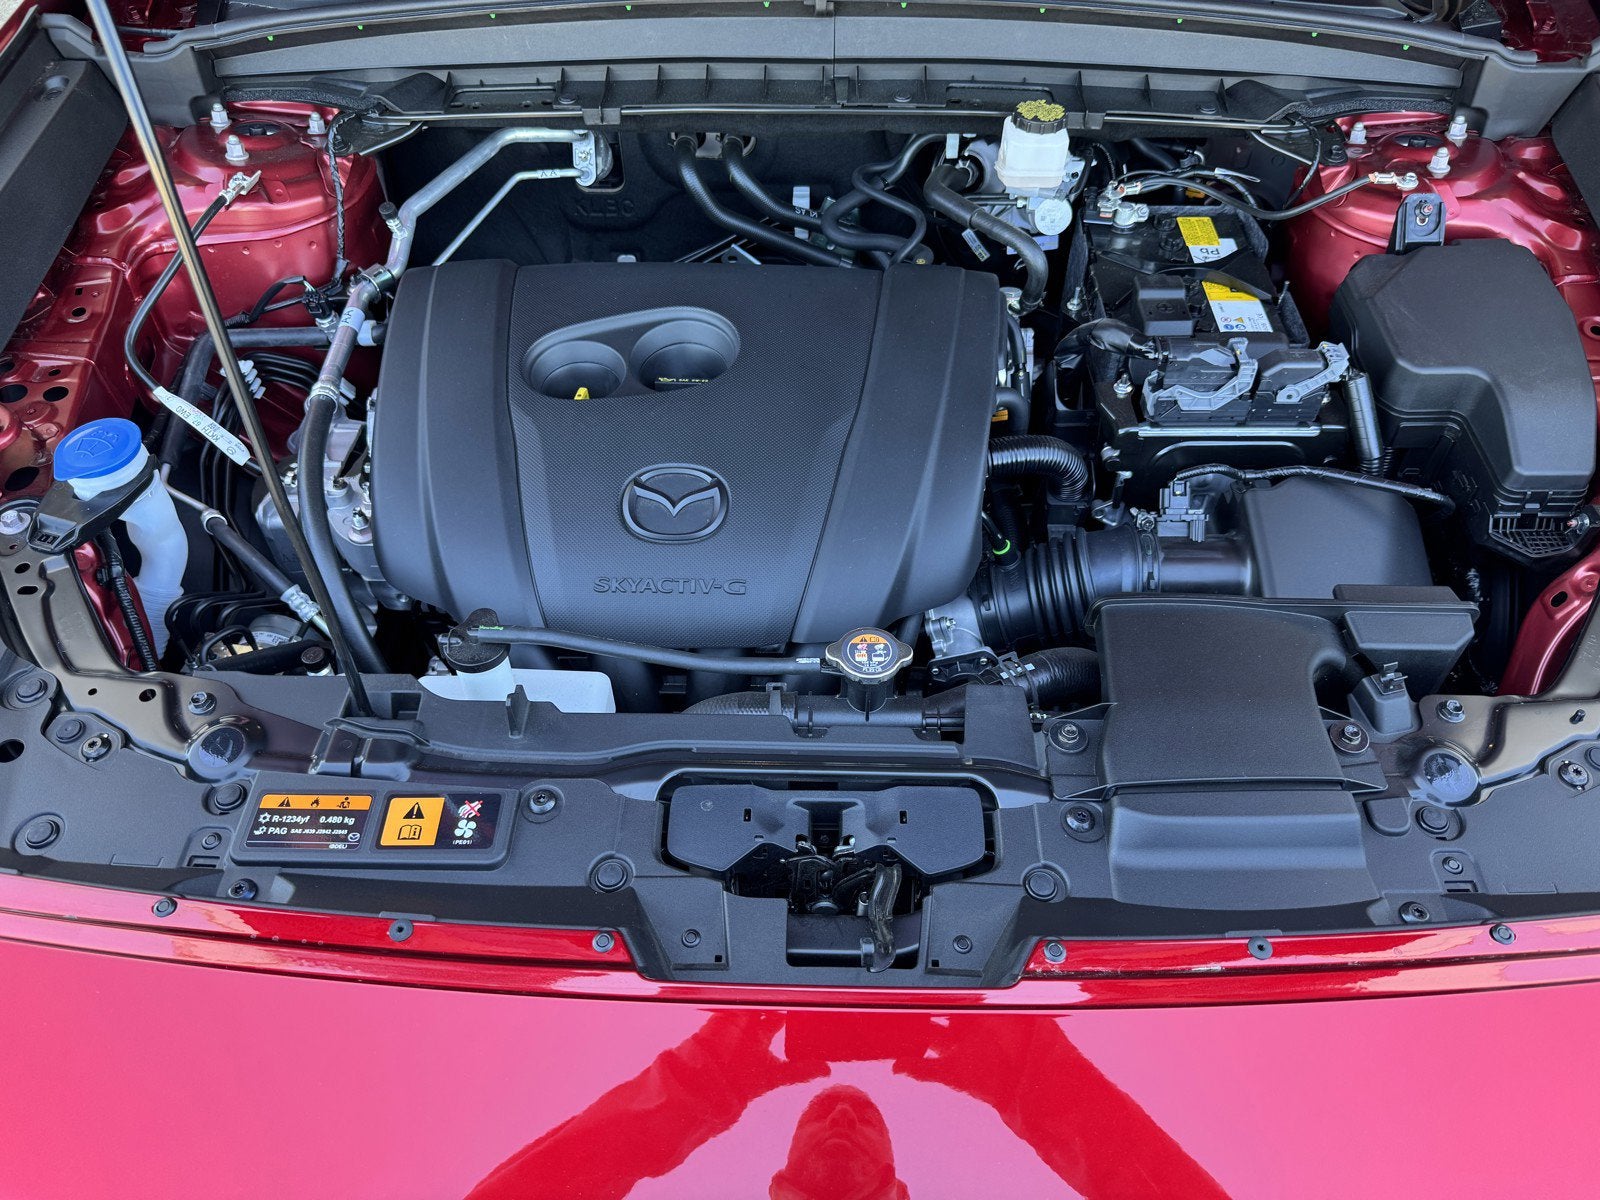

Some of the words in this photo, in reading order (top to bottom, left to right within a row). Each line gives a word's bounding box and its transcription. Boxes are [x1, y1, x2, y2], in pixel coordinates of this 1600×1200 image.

[1199, 247, 1221, 256] Pb
[593, 577, 748, 595] SKYACTIV-G
[271, 815, 311, 825] R-1234yf
[319, 816, 343, 825] 0.480
[343, 816, 356, 826] kg
[267, 827, 288, 835] PAG
